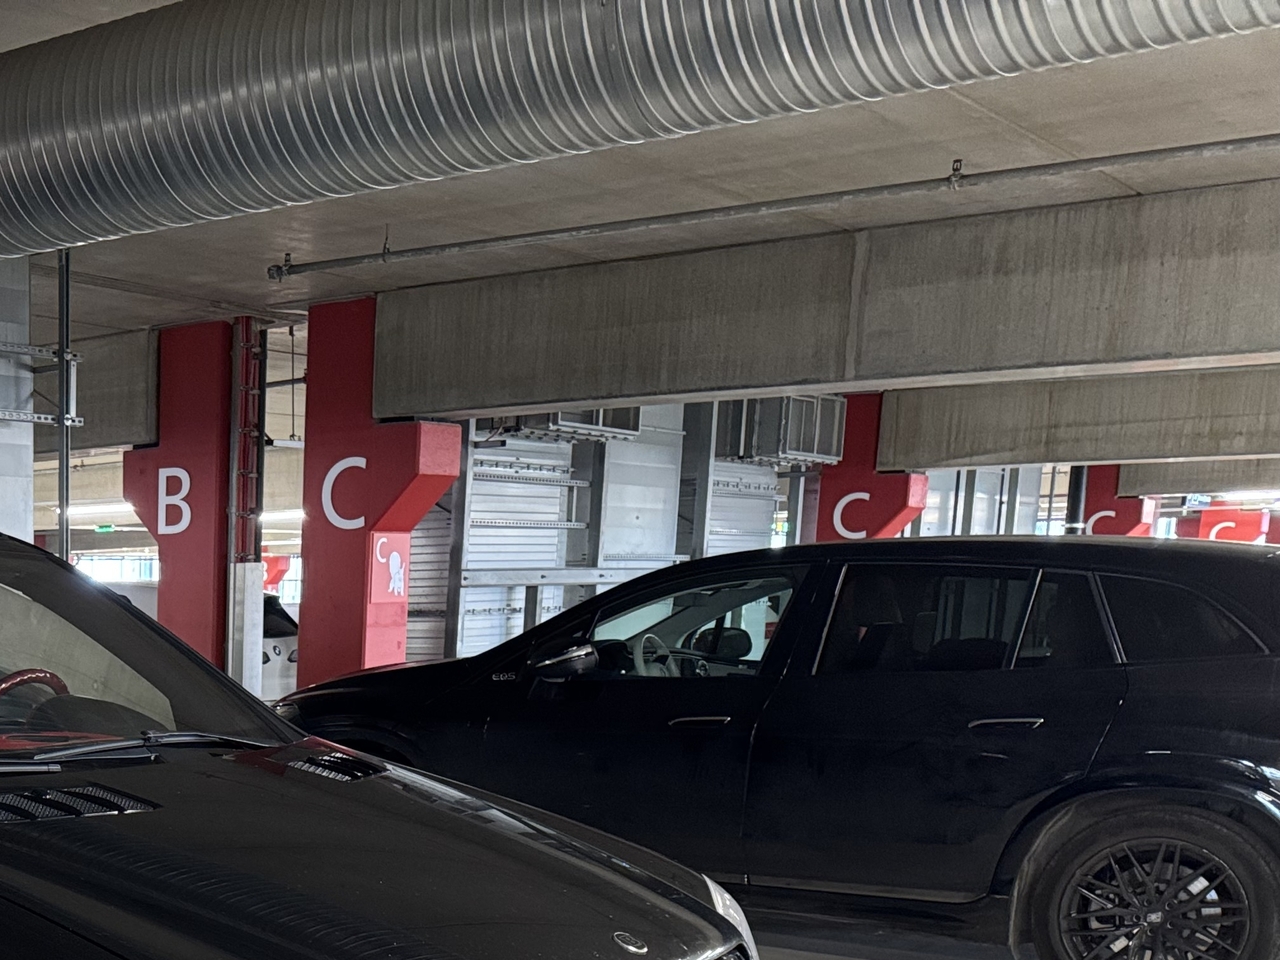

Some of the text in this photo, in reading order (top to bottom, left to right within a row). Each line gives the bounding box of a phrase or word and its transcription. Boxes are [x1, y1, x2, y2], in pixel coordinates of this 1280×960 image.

[157, 466, 192, 535] B
[321, 456, 367, 530] C
[832, 491, 871, 539] C
[375, 537, 388, 563] C
[491, 671, 516, 681] EQS
